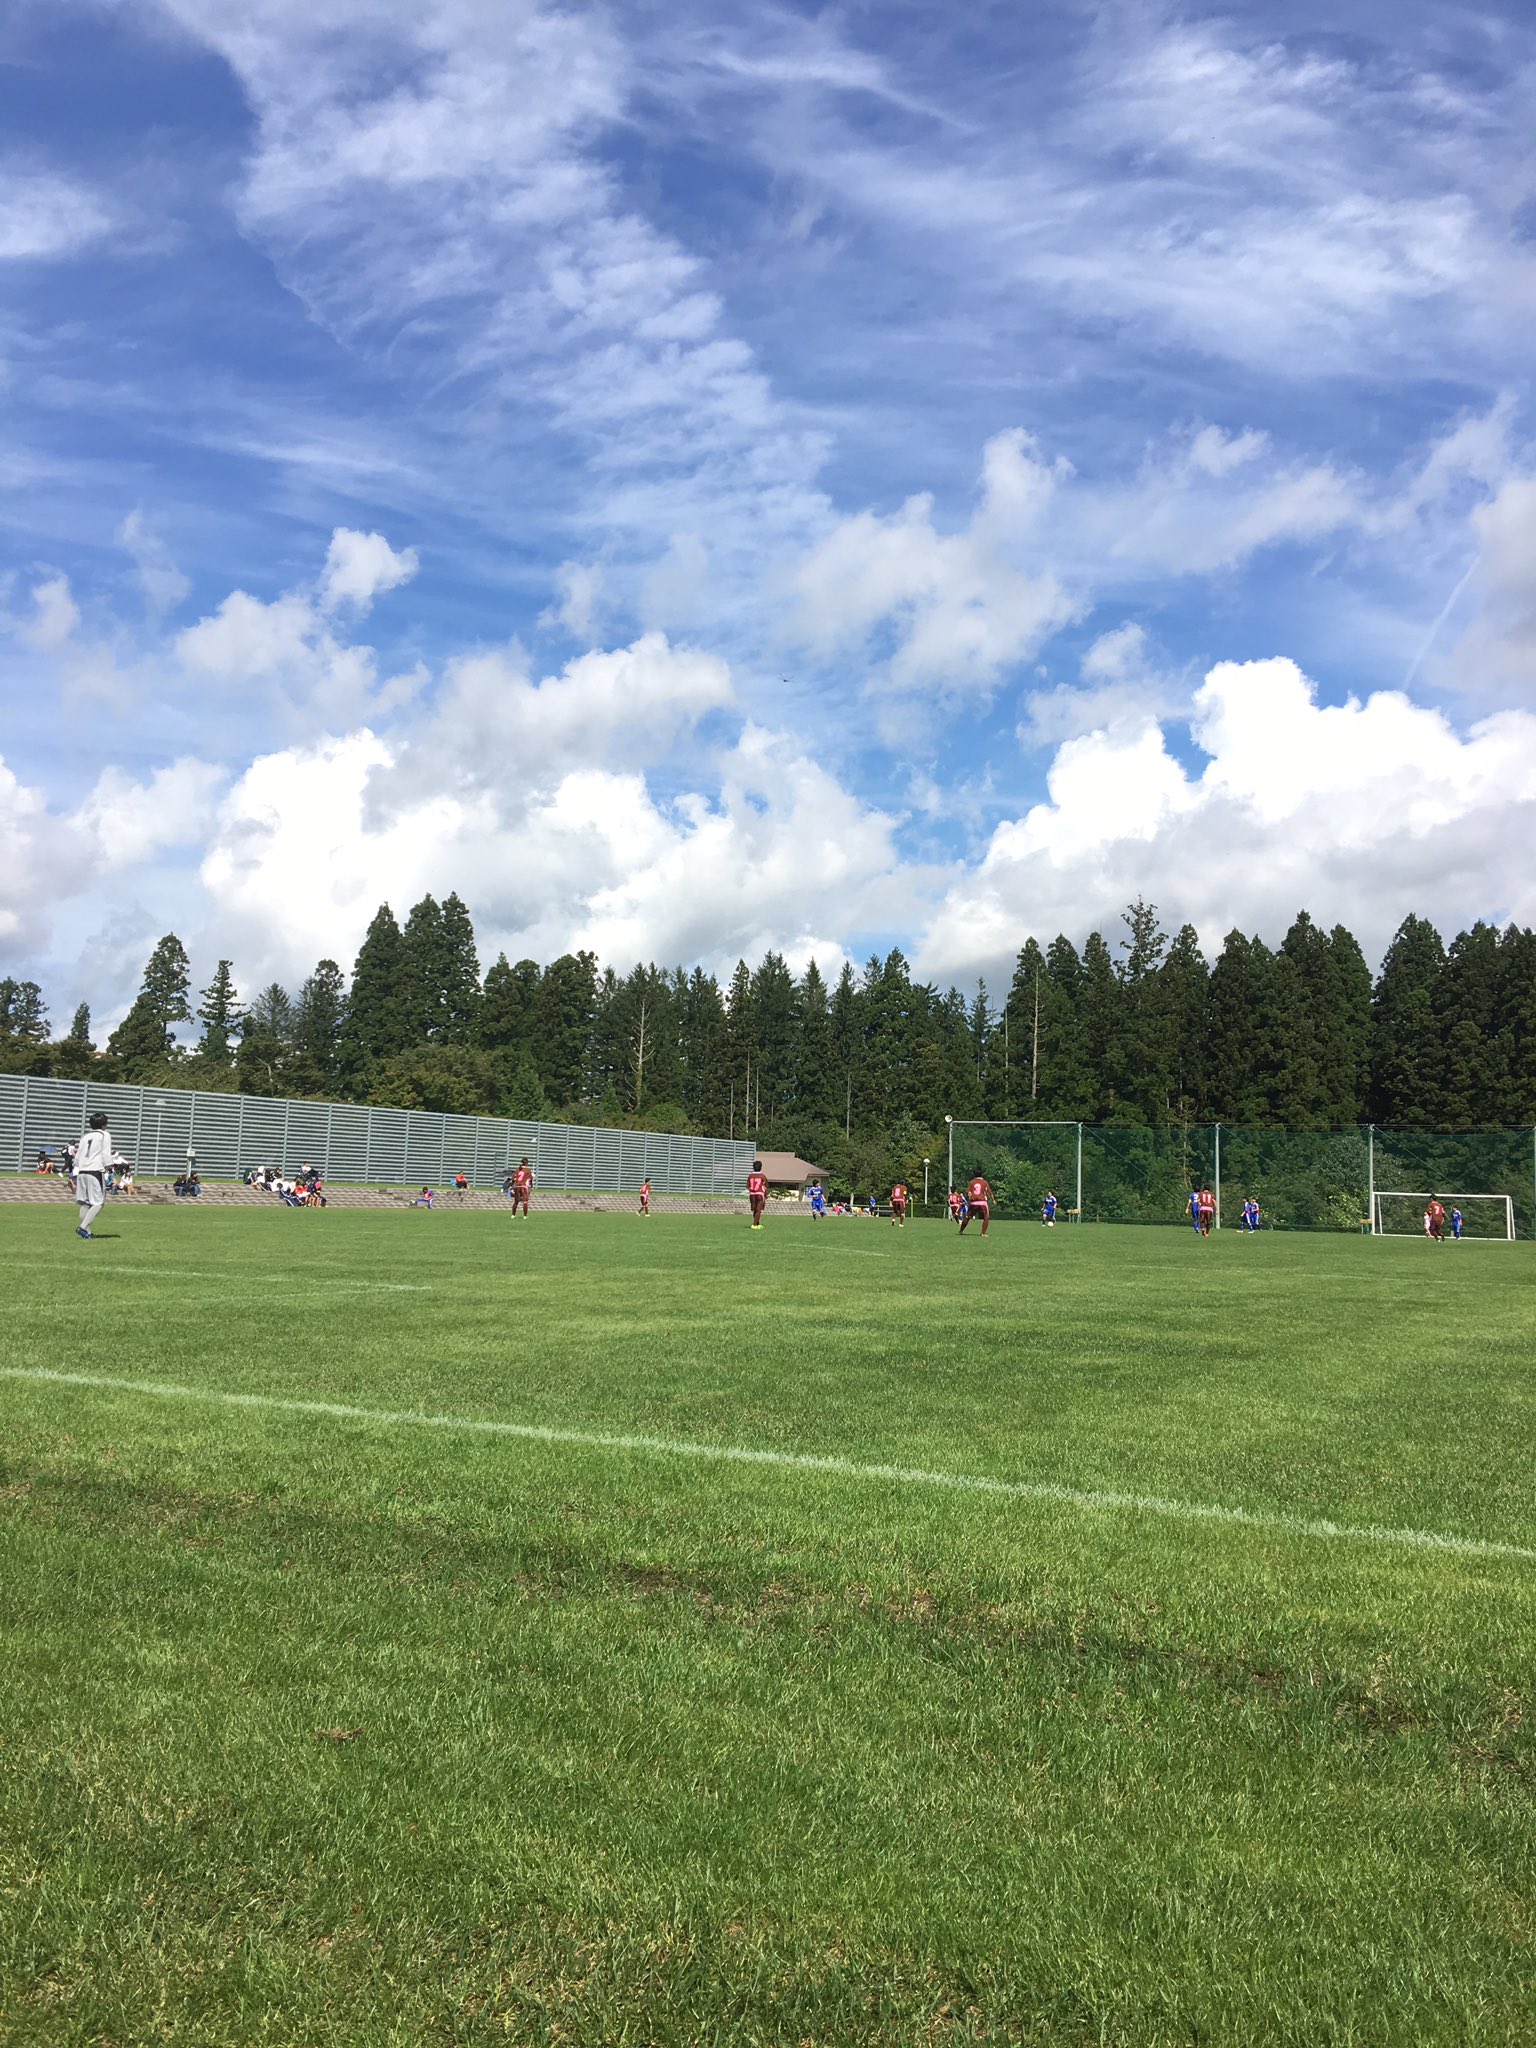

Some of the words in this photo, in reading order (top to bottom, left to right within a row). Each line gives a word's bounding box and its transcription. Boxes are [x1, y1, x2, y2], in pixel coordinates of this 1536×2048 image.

[85, 1139, 93, 1158] 1
[517, 1171, 525, 1182] 2
[749, 1178, 762, 1191] 17
[973, 1183, 982, 1196] 3
[1202, 1193, 1212, 1204] 11
[1434, 1205, 1440, 1215] 7
